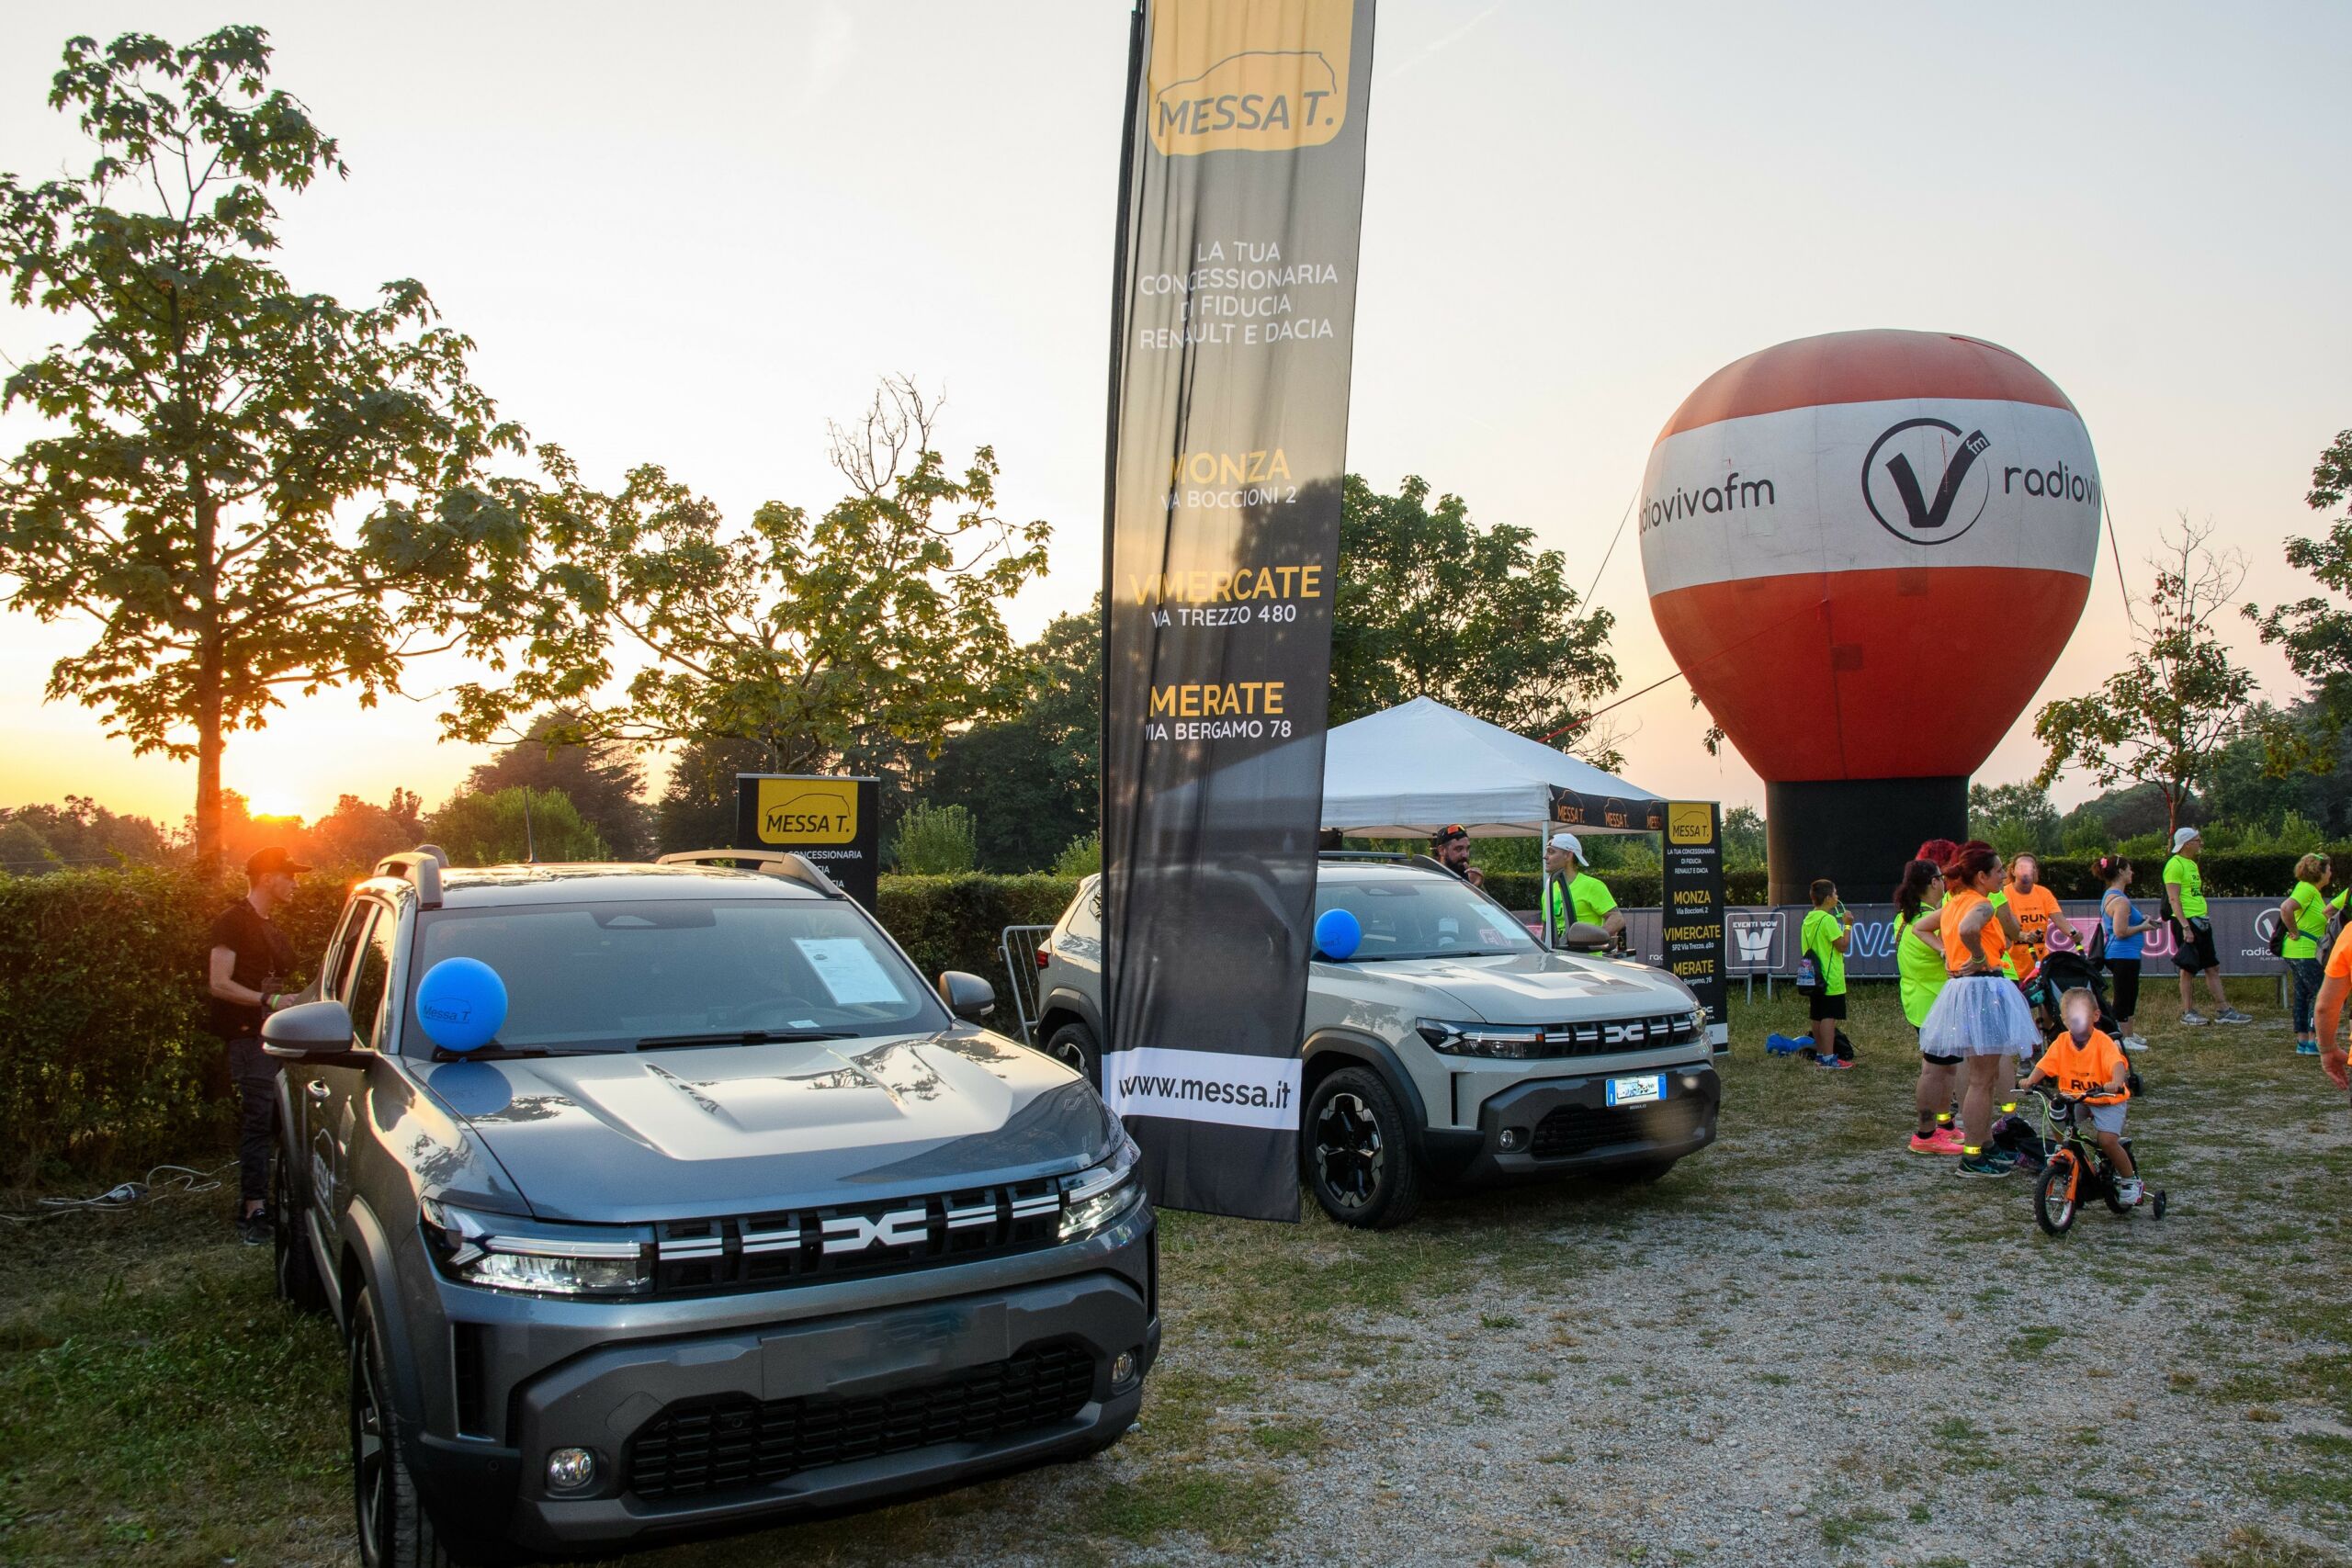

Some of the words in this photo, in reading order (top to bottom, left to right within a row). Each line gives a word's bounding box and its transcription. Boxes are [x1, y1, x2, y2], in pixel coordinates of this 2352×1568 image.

[1158, 94, 1290, 137] MESSA
[1303, 91, 1334, 127] T.
[1197, 242, 1225, 262] LA
[1234, 242, 1281, 263] TUA
[1140, 264, 1338, 295] CONCESSIONARIA
[1181, 298, 1194, 321] DI
[1201, 294, 1291, 318] FIDUCIA
[1140, 323, 1235, 349] RENAULT
[1244, 325, 1257, 344] E
[1265, 319, 1333, 343] DACIA
[1966, 436, 1988, 456] fm
[1169, 448, 1291, 486] MONZA
[1160, 491, 1182, 511] VIA
[1187, 487, 1277, 508] BOCCIONI
[1286, 486, 1296, 503] 2
[1129, 566, 1321, 605] VIMERCATE
[1151, 609, 1170, 628] VIA
[1178, 606, 1250, 626] TREZZO
[1258, 604, 1296, 623] 480
[1149, 682, 1283, 717] MERATE
[1146, 722, 1168, 740] VIA
[1176, 721, 1262, 740] BERGAMO
[1270, 720, 1291, 738] 78
[766, 815, 830, 832] MESSA
[836, 815, 850, 832] T.
[1673, 825, 1700, 837] MESSA
[1702, 825, 1709, 837] T.
[1674, 890, 1711, 905] MONZA
[1663, 925, 1721, 942] VIMERCATE
[1673, 960, 1714, 976] MERATE
[1118, 1075, 1291, 1109] www.messa.it
